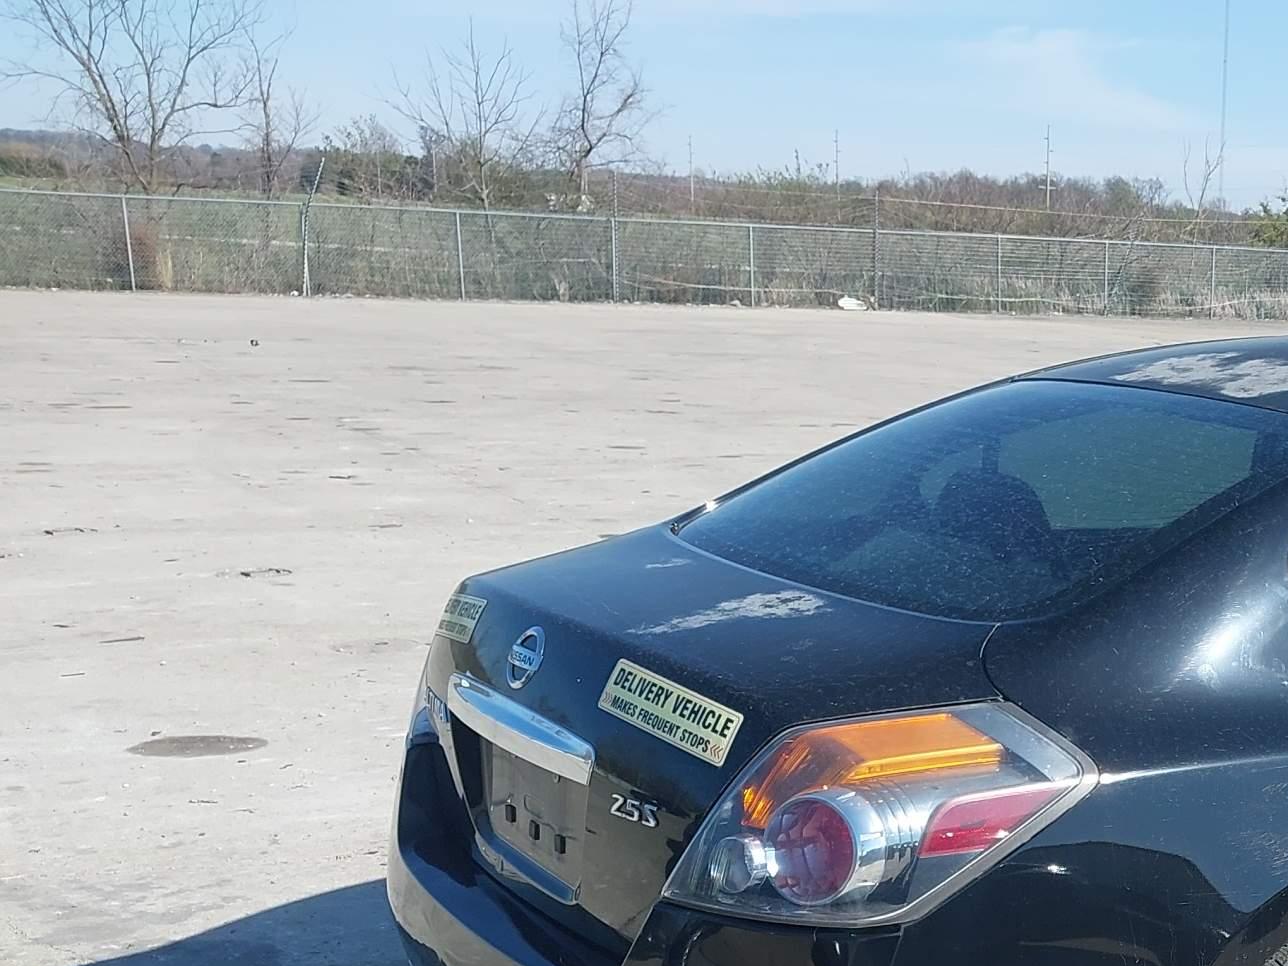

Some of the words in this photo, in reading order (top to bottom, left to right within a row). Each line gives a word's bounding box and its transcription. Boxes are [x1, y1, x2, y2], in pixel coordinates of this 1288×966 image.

[610, 695, 638, 717] MAKES
[637, 708, 681, 739] FREQUENT
[680, 729, 711, 753] STOPS
[613, 668, 674, 709] DELIVERY
[671, 694, 735, 739] VEHICLE
